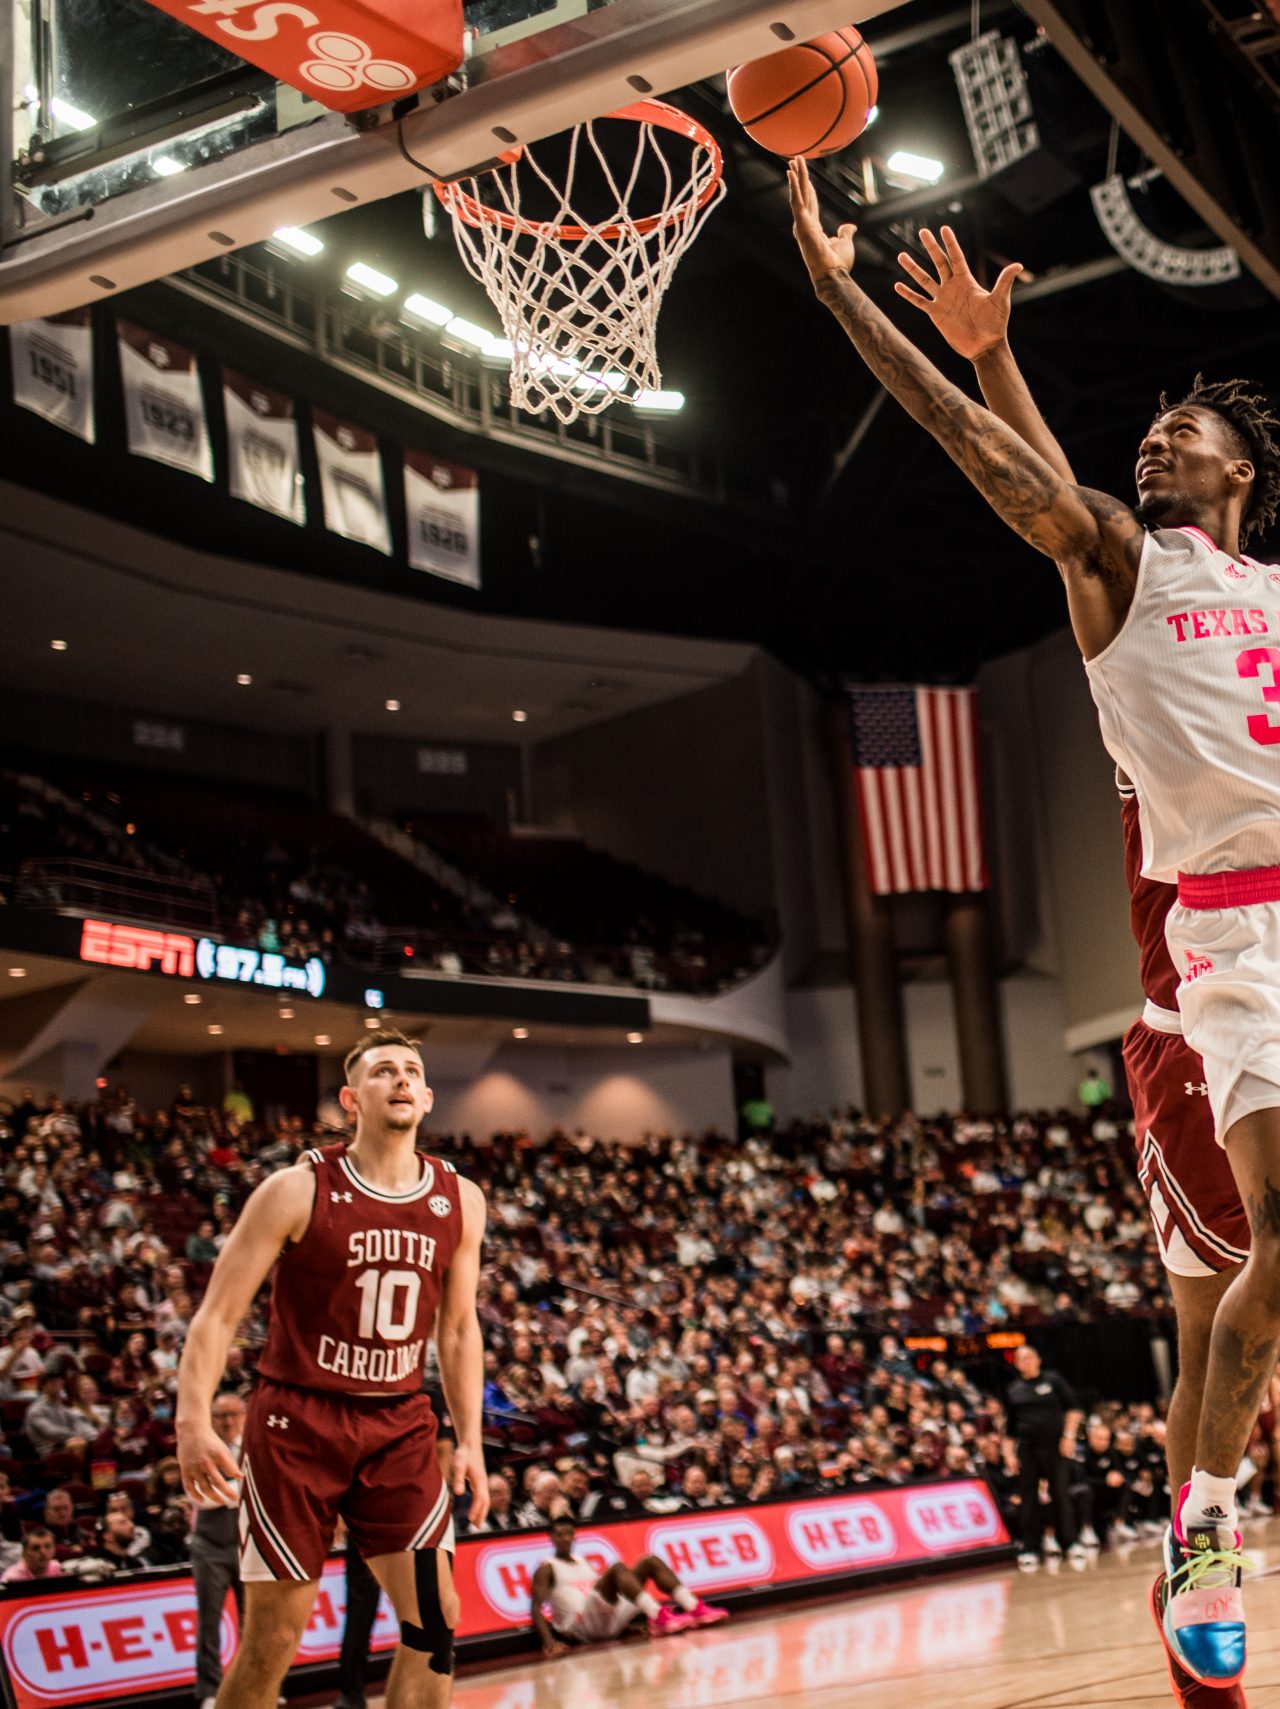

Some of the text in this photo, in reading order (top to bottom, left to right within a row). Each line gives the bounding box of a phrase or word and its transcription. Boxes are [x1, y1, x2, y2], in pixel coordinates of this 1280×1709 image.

[1167, 608, 1268, 642] TEXAS
[80, 919, 194, 977] ESPN
[347, 1229, 437, 1272] SOUTH
[355, 1269, 421, 1340] 10
